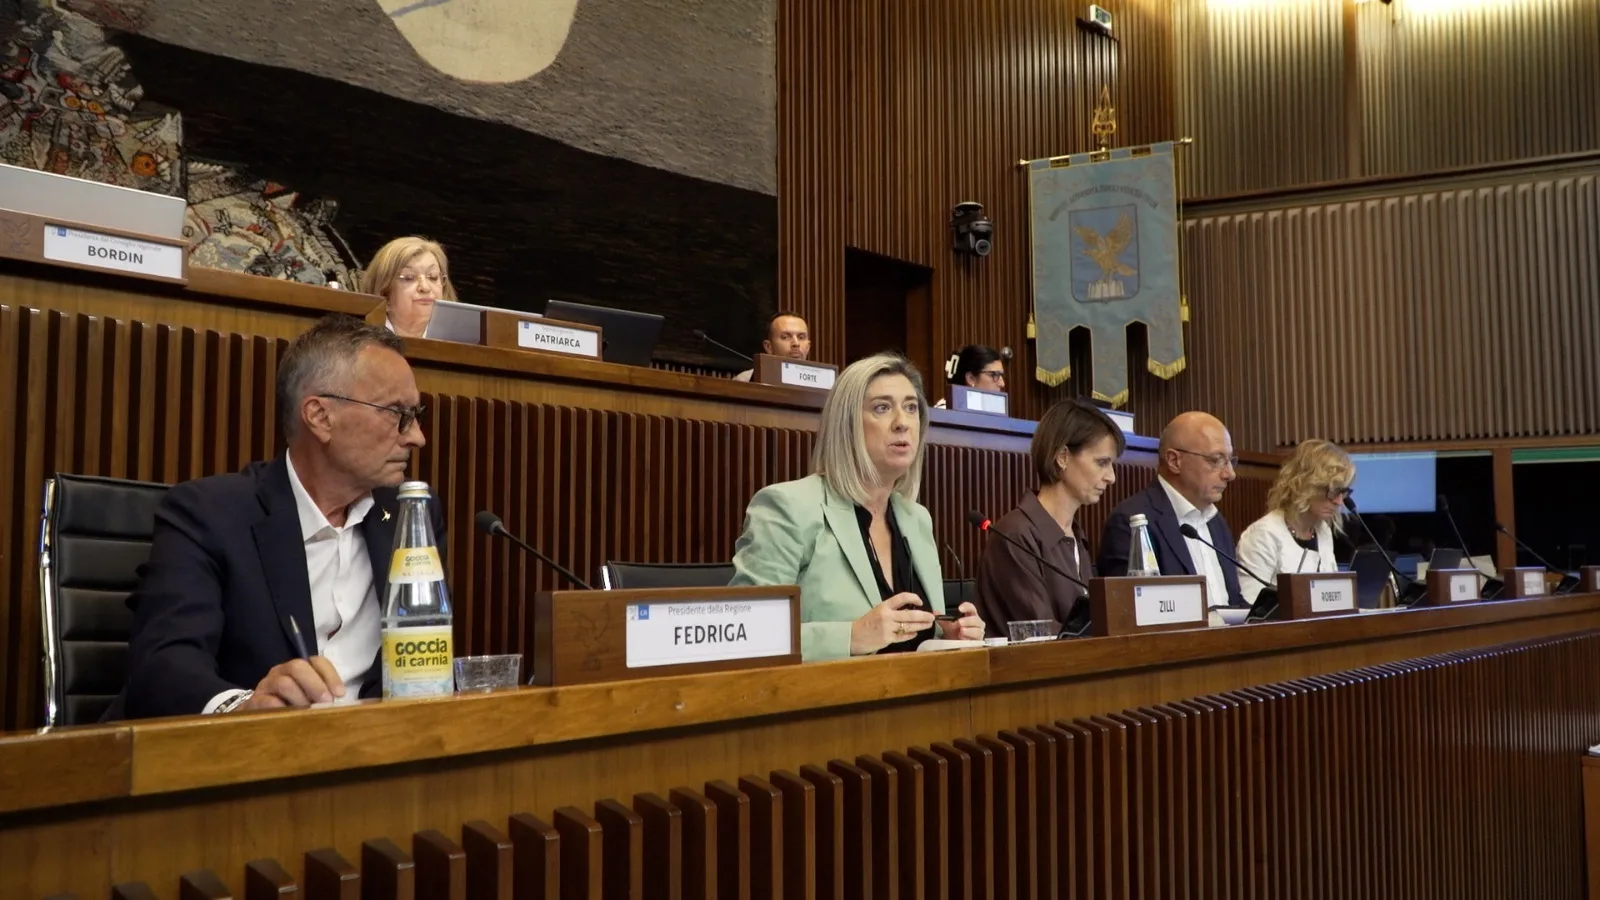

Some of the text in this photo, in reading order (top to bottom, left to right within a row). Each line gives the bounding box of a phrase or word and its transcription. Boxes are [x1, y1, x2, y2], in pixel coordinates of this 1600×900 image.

[88, 245, 143, 264] BORDIN
[535, 333, 580, 348] PATRIARCA
[799, 372, 817, 383] FORTE
[1321, 591, 1341, 602] ROBERTI
[668, 603, 752, 616] Presidente della Regione
[1159, 600, 1175, 613] ZILLI
[674, 623, 747, 646] FEDRIGA
[395, 654, 448, 667] di carnia
